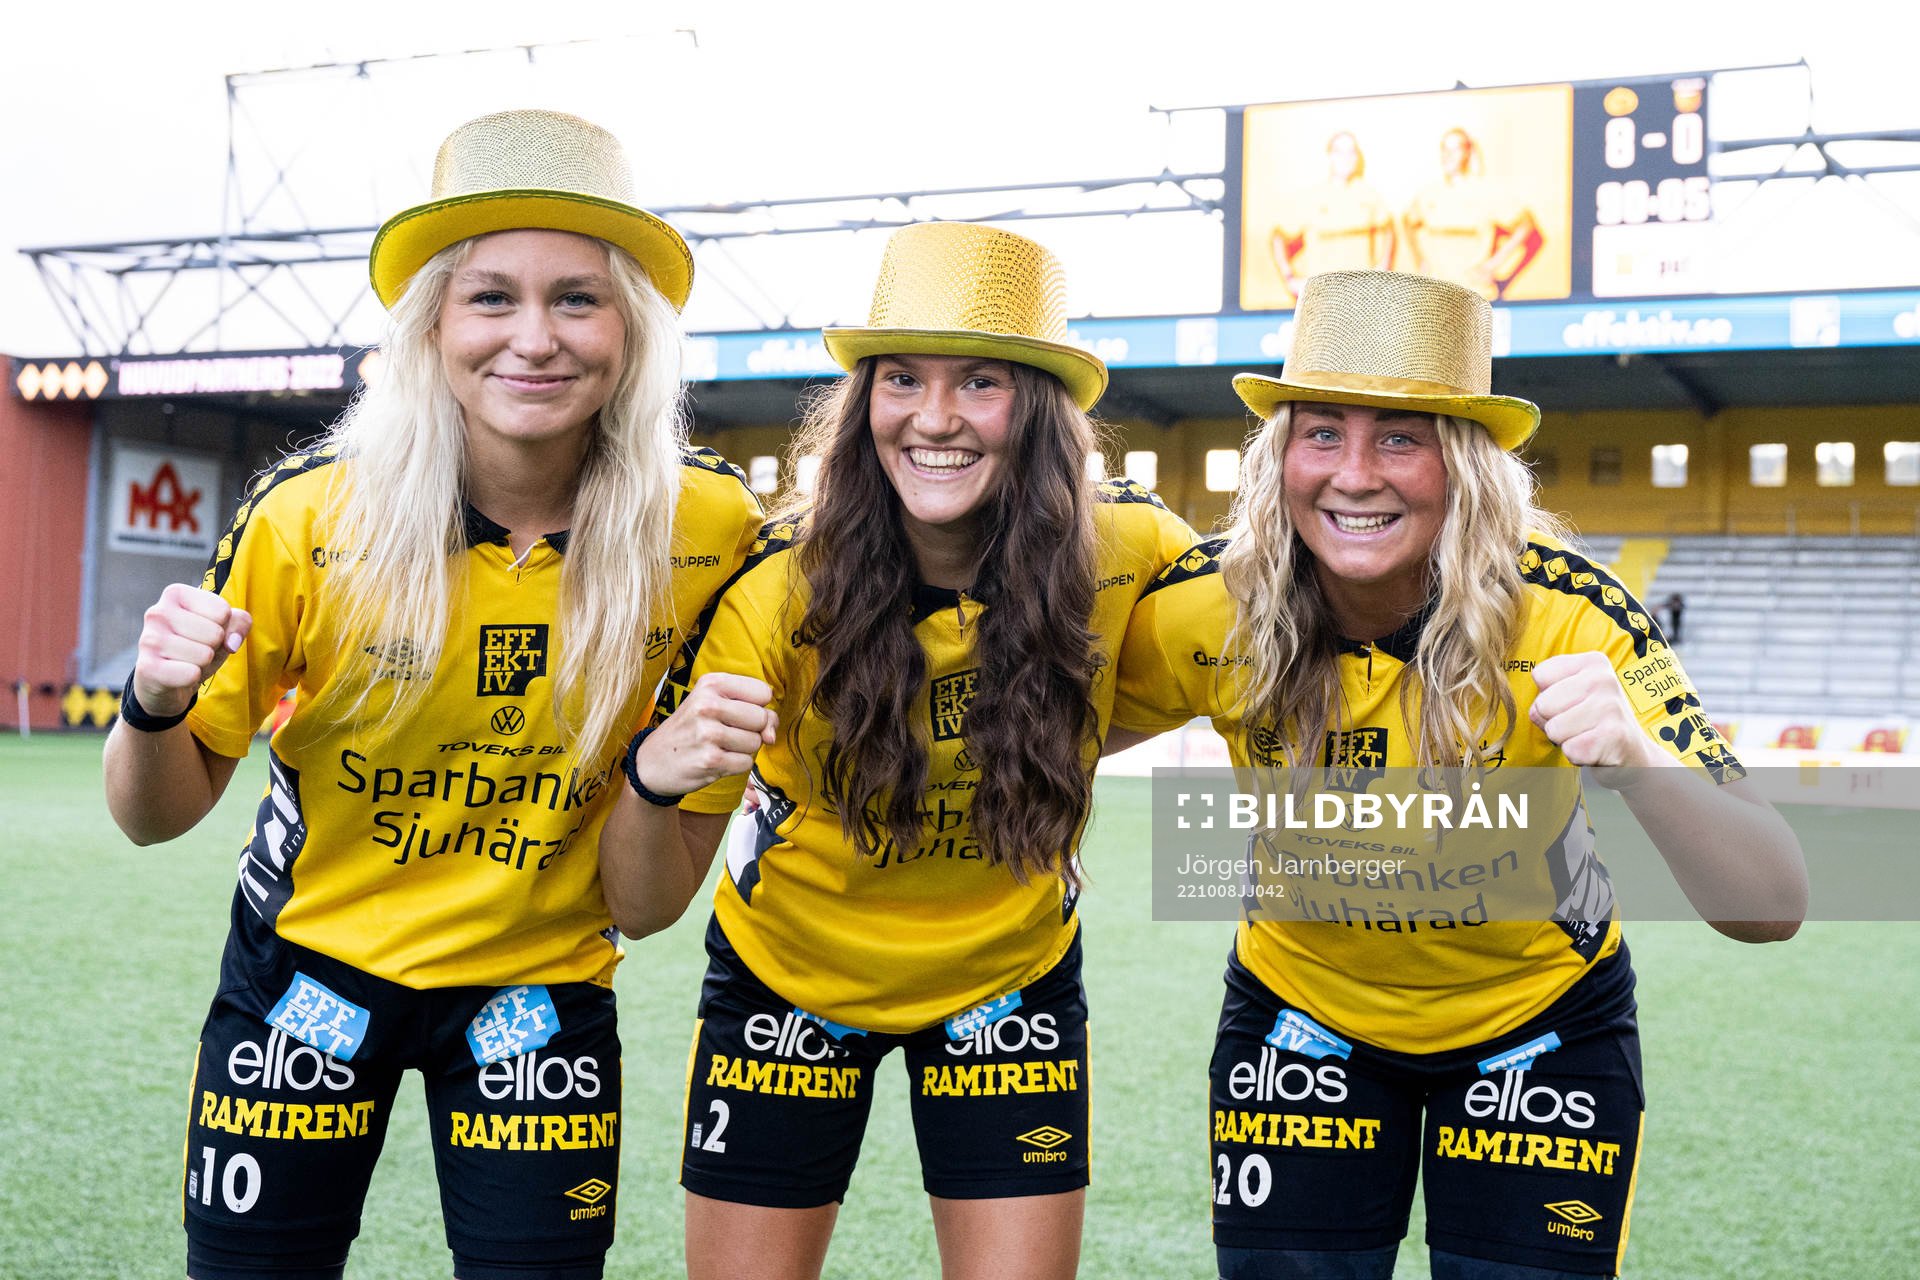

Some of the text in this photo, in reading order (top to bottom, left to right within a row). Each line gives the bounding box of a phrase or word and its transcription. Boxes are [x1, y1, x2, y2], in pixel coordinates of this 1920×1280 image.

[485, 629, 537, 650] EFF
[484, 650, 542, 671] EKT
[483, 671, 515, 692] IV
[935, 672, 978, 699] EFF
[438, 743, 534, 757] TOVEKS
[1331, 732, 1378, 750] EFF
[1331, 750, 1383, 771] EKT
[1294, 833, 1420, 856] TOVEKS BIL
[288, 979, 358, 1029] EFF
[472, 986, 529, 1035] EFF
[278, 1003, 354, 1057] EKT
[475, 1004, 547, 1058] EKT
[1271, 1026, 1313, 1051] IV
[227, 1028, 356, 1091] ellos
[478, 1050, 600, 1101] ellos
[706, 1054, 861, 1099] RAMIRENT
[922, 1059, 1079, 1097] RAMIRENT
[1229, 1046, 1348, 1103] ellos
[199, 1091, 375, 1141] RAMIRENT
[1464, 1070, 1596, 1129] ellos
[450, 1111, 617, 1151] RAMIRENT
[701, 1098, 731, 1154] 2
[1214, 1110, 1381, 1150] RAMIRENT
[1023, 1150, 1067, 1164] umbro
[1437, 1126, 1621, 1176] RAMIRENT
[201, 1146, 262, 1214] 10
[1216, 1153, 1273, 1208] 20
[570, 1204, 607, 1221] umbro
[1547, 1221, 1595, 1241] umbro
